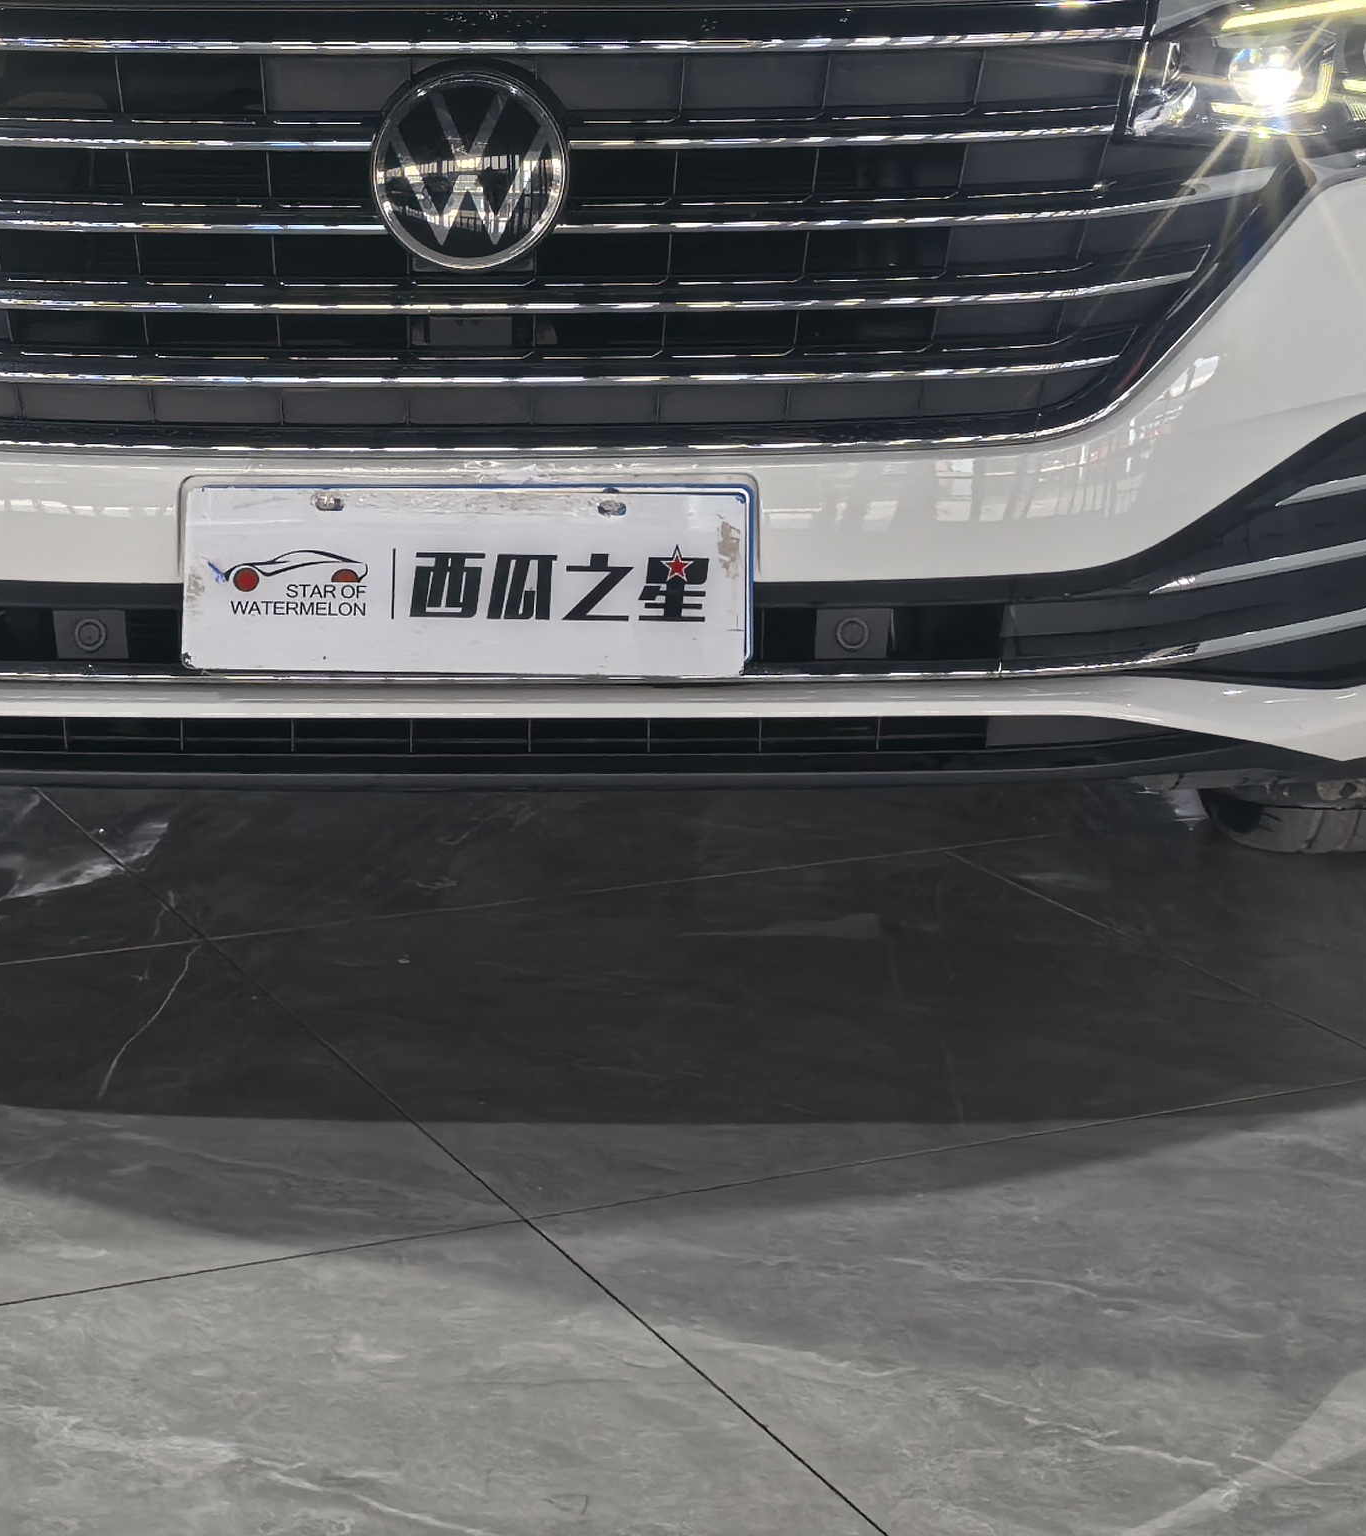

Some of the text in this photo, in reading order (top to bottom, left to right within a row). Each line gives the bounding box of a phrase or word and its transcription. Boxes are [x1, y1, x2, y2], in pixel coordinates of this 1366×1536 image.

[286, 583, 367, 600] STAR OF
[409, 544, 710, 623] 西瓜之星
[230, 600, 367, 617] WATERMELON
